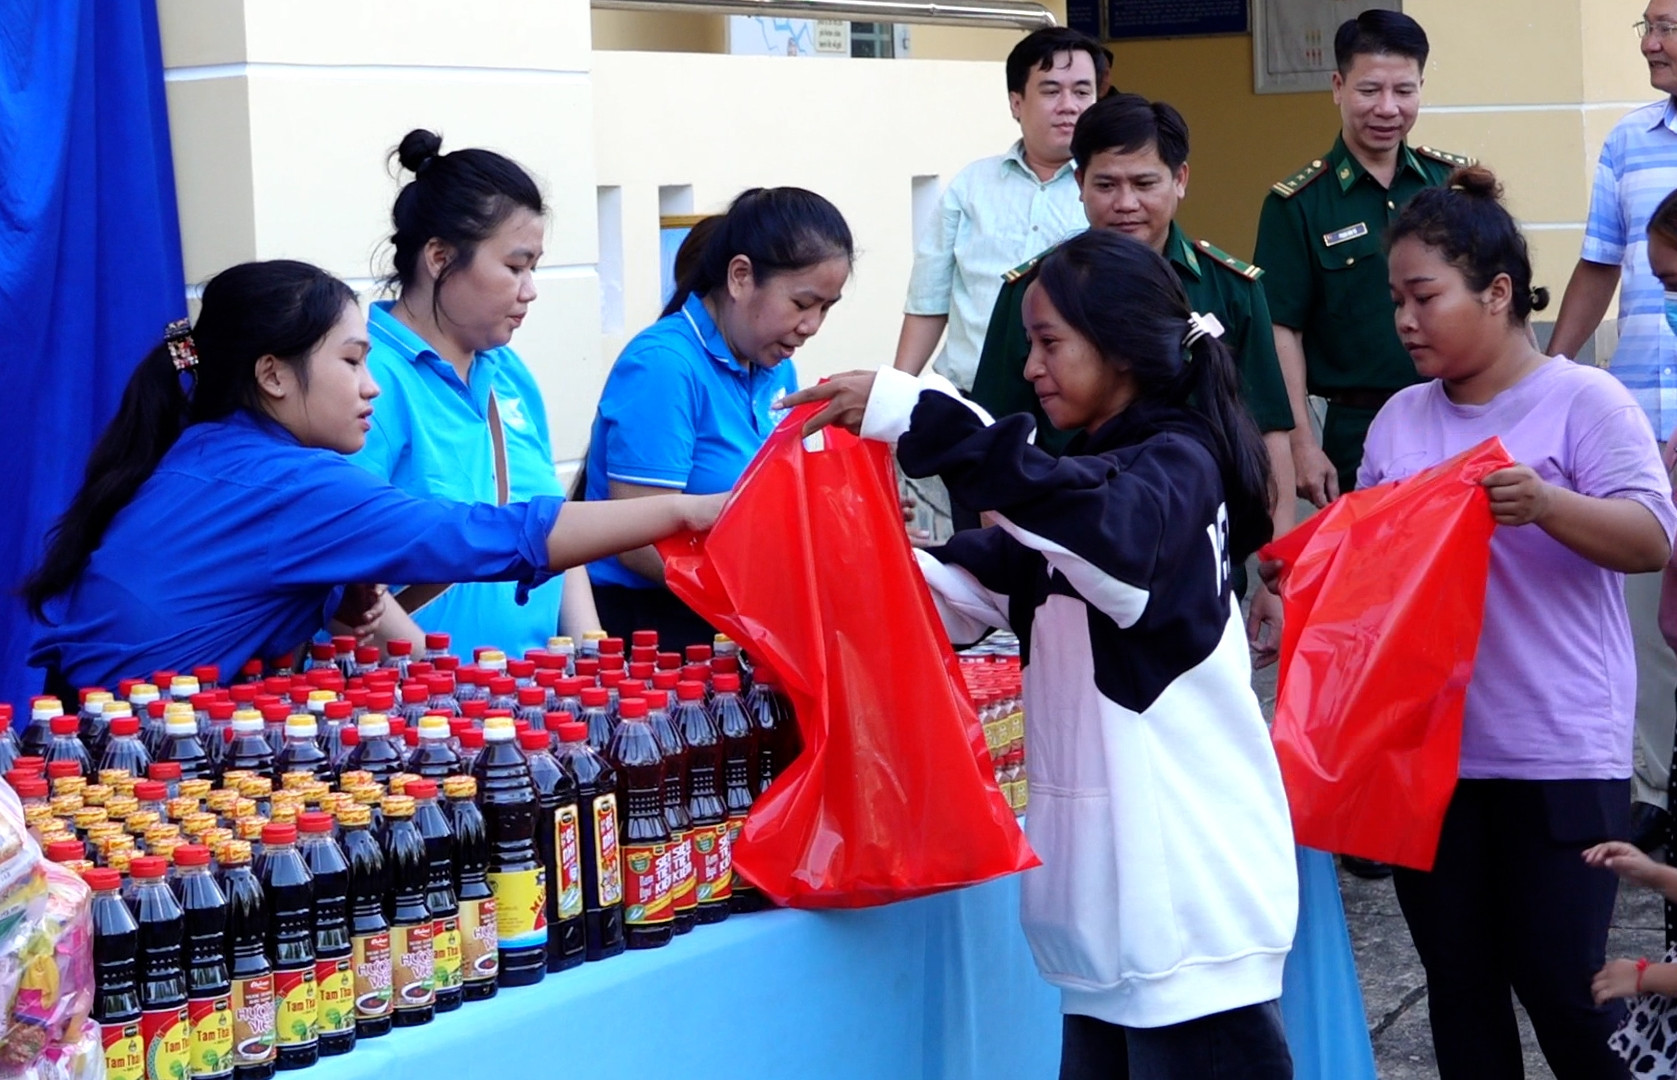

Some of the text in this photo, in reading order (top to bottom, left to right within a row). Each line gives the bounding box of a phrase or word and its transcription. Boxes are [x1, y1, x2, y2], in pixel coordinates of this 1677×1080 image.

[320, 989, 338, 1001] Tam
[286, 1001, 304, 1012] Tam
[197, 1030, 217, 1042] Tam
[164, 1041, 182, 1053] Tam
[105, 1056, 125, 1068] Tam
